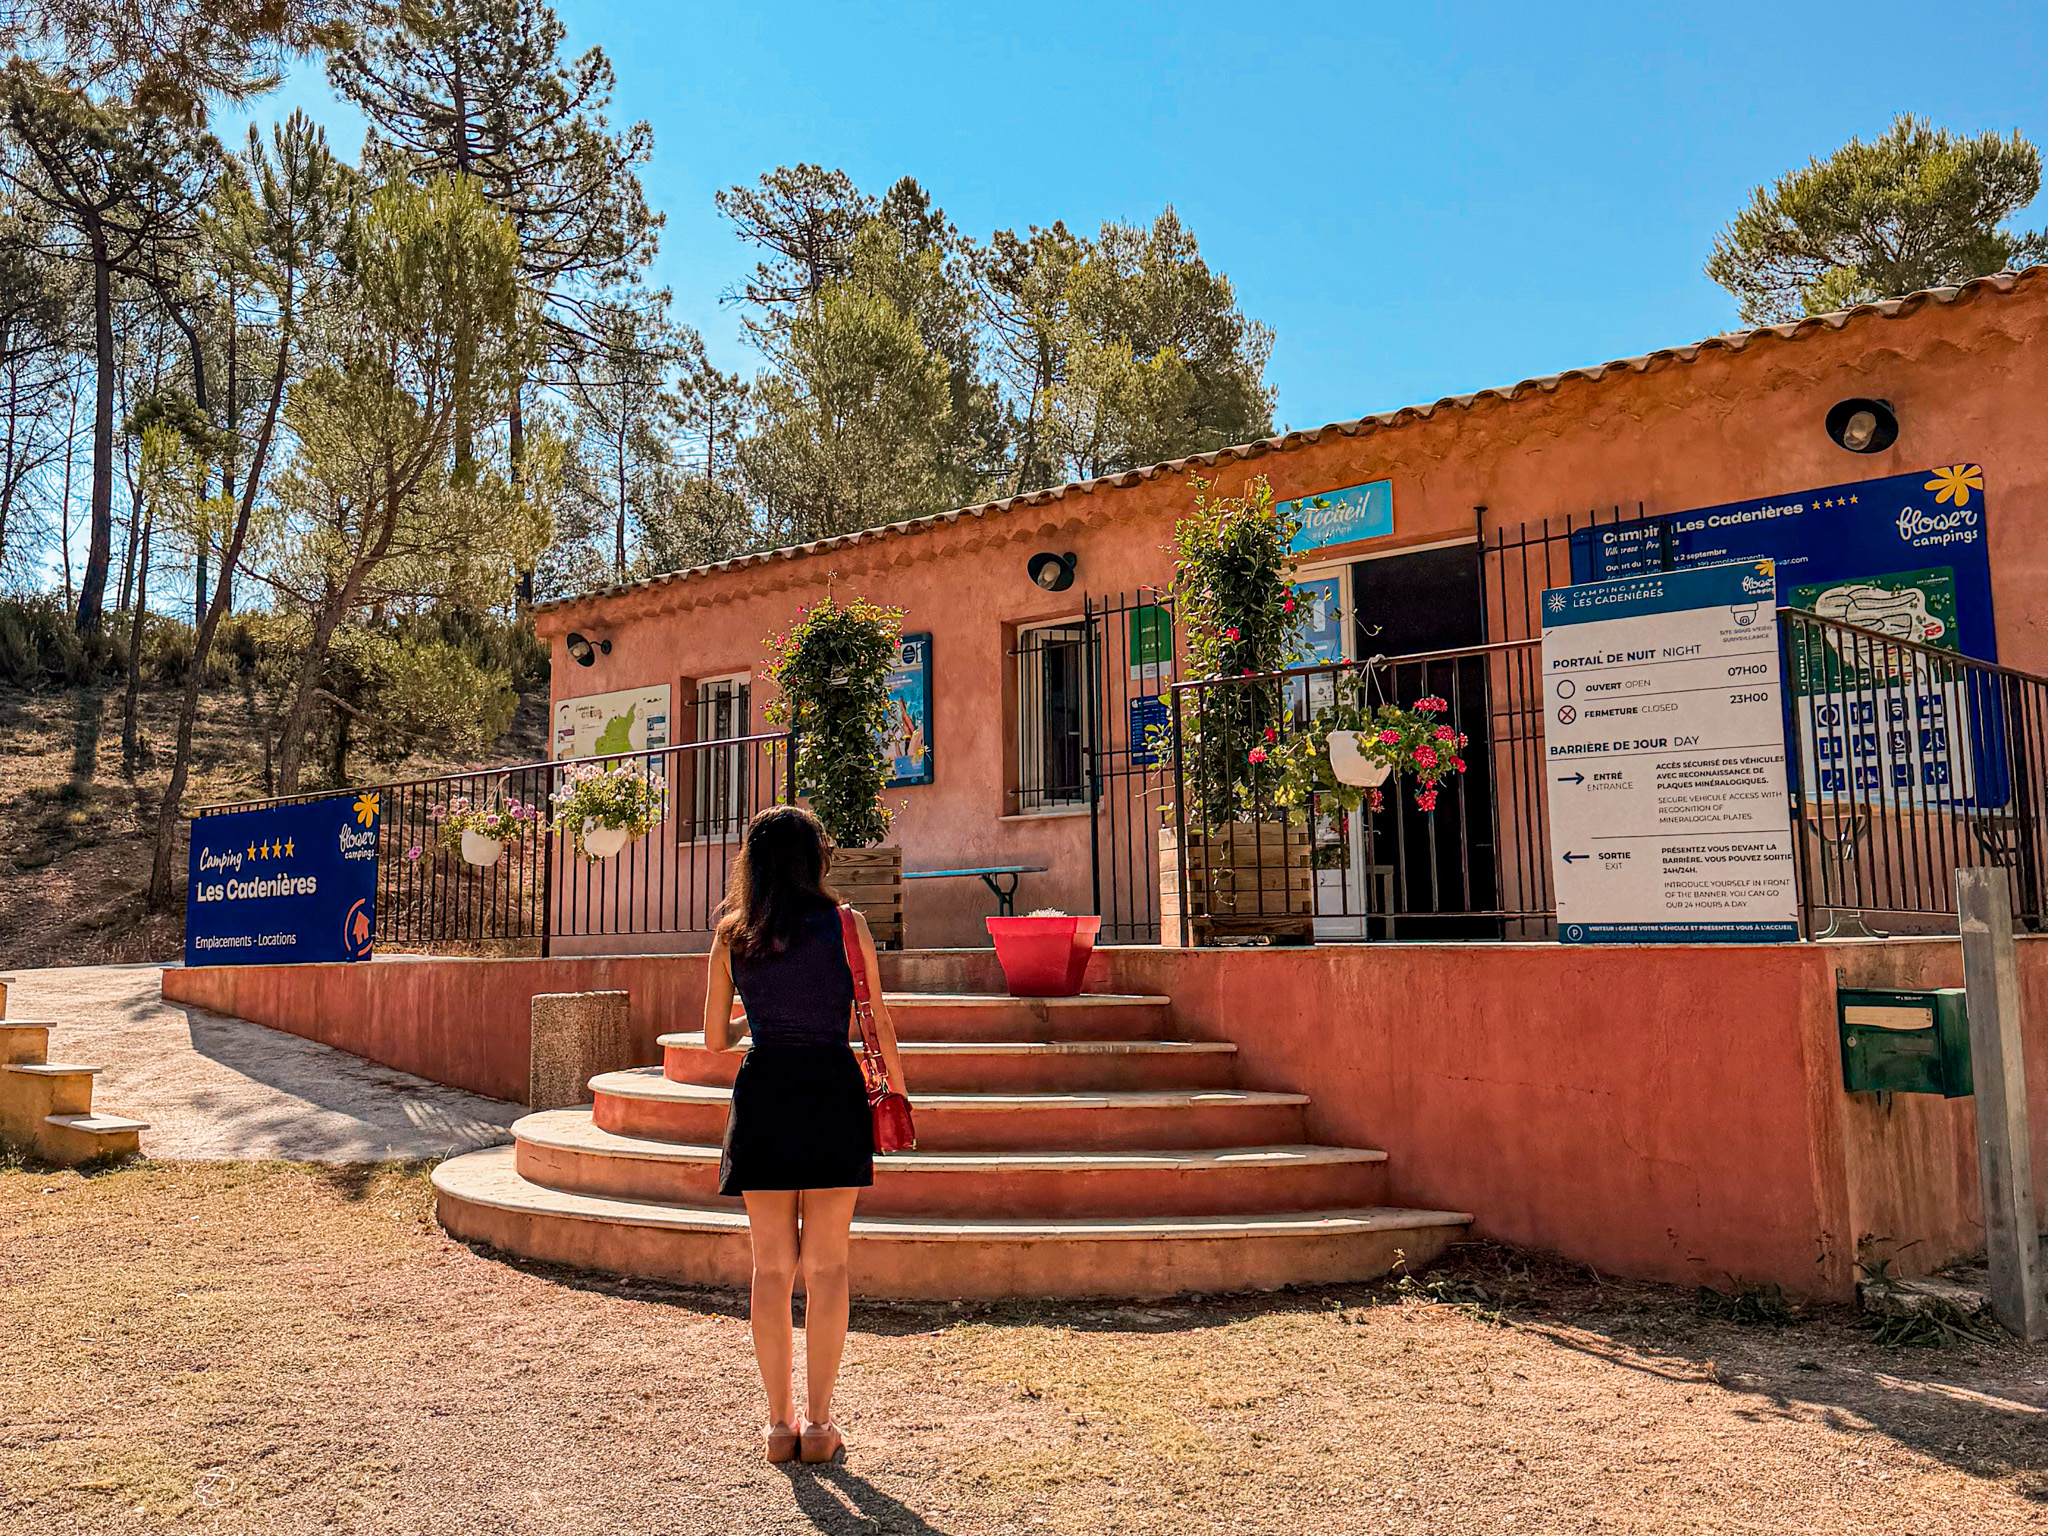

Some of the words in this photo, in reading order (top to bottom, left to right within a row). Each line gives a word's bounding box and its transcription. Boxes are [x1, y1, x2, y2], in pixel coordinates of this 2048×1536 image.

[1676, 519, 1705, 533] Les
[1707, 503, 1804, 528] Cadenières
[1895, 506, 1978, 540] flower
[1912, 529, 1978, 547] campings
[1686, 548, 1728, 561] septembre
[1631, 561, 1642, 569] du
[1573, 585, 1626, 598] CAMPING
[1573, 598, 1592, 608] LES
[1594, 588, 1664, 605] CADENIÈRES
[1553, 655, 1604, 669] PORTAIL
[1607, 653, 1624, 663] DE
[1627, 649, 1656, 661] NUIT
[1662, 644, 1702, 657] NIGHT
[1727, 664, 1767, 676] 07H00
[1585, 682, 1622, 692] OUVERT
[1625, 680, 1651, 689] OPEN
[1729, 692, 1768, 704] 23H00
[1584, 707, 1638, 718] FERMETURE
[1641, 703, 1678, 714] CLOSED
[1550, 741, 1610, 755] BARRIÈRE
[1613, 741, 1630, 751] DE
[1633, 738, 1668, 750] JOUR
[1674, 735, 1700, 747] DAY
[1655, 761, 1681, 770] ACCÈS
[1722, 758, 1738, 766] DES
[1740, 755, 1784, 764] VÉHICULES
[1593, 771, 1623, 781] ENTRÉ
[1656, 772, 1677, 780] AVEC
[1678, 768, 1751, 778] RECONNAISSANCE
[1587, 781, 1634, 792] ENTRANCE
[1657, 781, 1693, 790] PLAQUES
[1658, 796, 1688, 804] SECURE
[1729, 792, 1759, 800] ACCESS
[1760, 790, 1783, 798] WITH
[1658, 804, 1711, 814] RECOGNITION
[1659, 814, 1721, 824] MINERALOGICAL
[338, 823, 376, 852] flower
[344, 847, 375, 861] campings
[1707, 845, 1730, 853] VOUS
[1731, 844, 1765, 852] DEVANT
[1766, 843, 1777, 851] LA
[200, 846, 242, 874] Camping
[1598, 851, 1631, 861] SORTIE
[1704, 855, 1727, 863] VOUS
[1728, 854, 1762, 862] POUVEZ
[1605, 862, 1624, 870] EXIT
[197, 881, 224, 902] Les
[226, 873, 317, 900] Cadenières
[1664, 880, 1709, 888] INTRODUCE
[1710, 879, 1750, 888] YOURSELF
[1752, 879, 1761, 887] IN
[1763, 878, 1791, 887] FRONT
[1747, 889, 1765, 897] CAN
[1766, 889, 1780, 897] GO
[1665, 901, 1683, 909] OUR
[1695, 901, 1723, 909] HOURS
[1731, 900, 1748, 908] DAY
[195, 935, 252, 950] Emplacements
[258, 932, 297, 946] Locations
